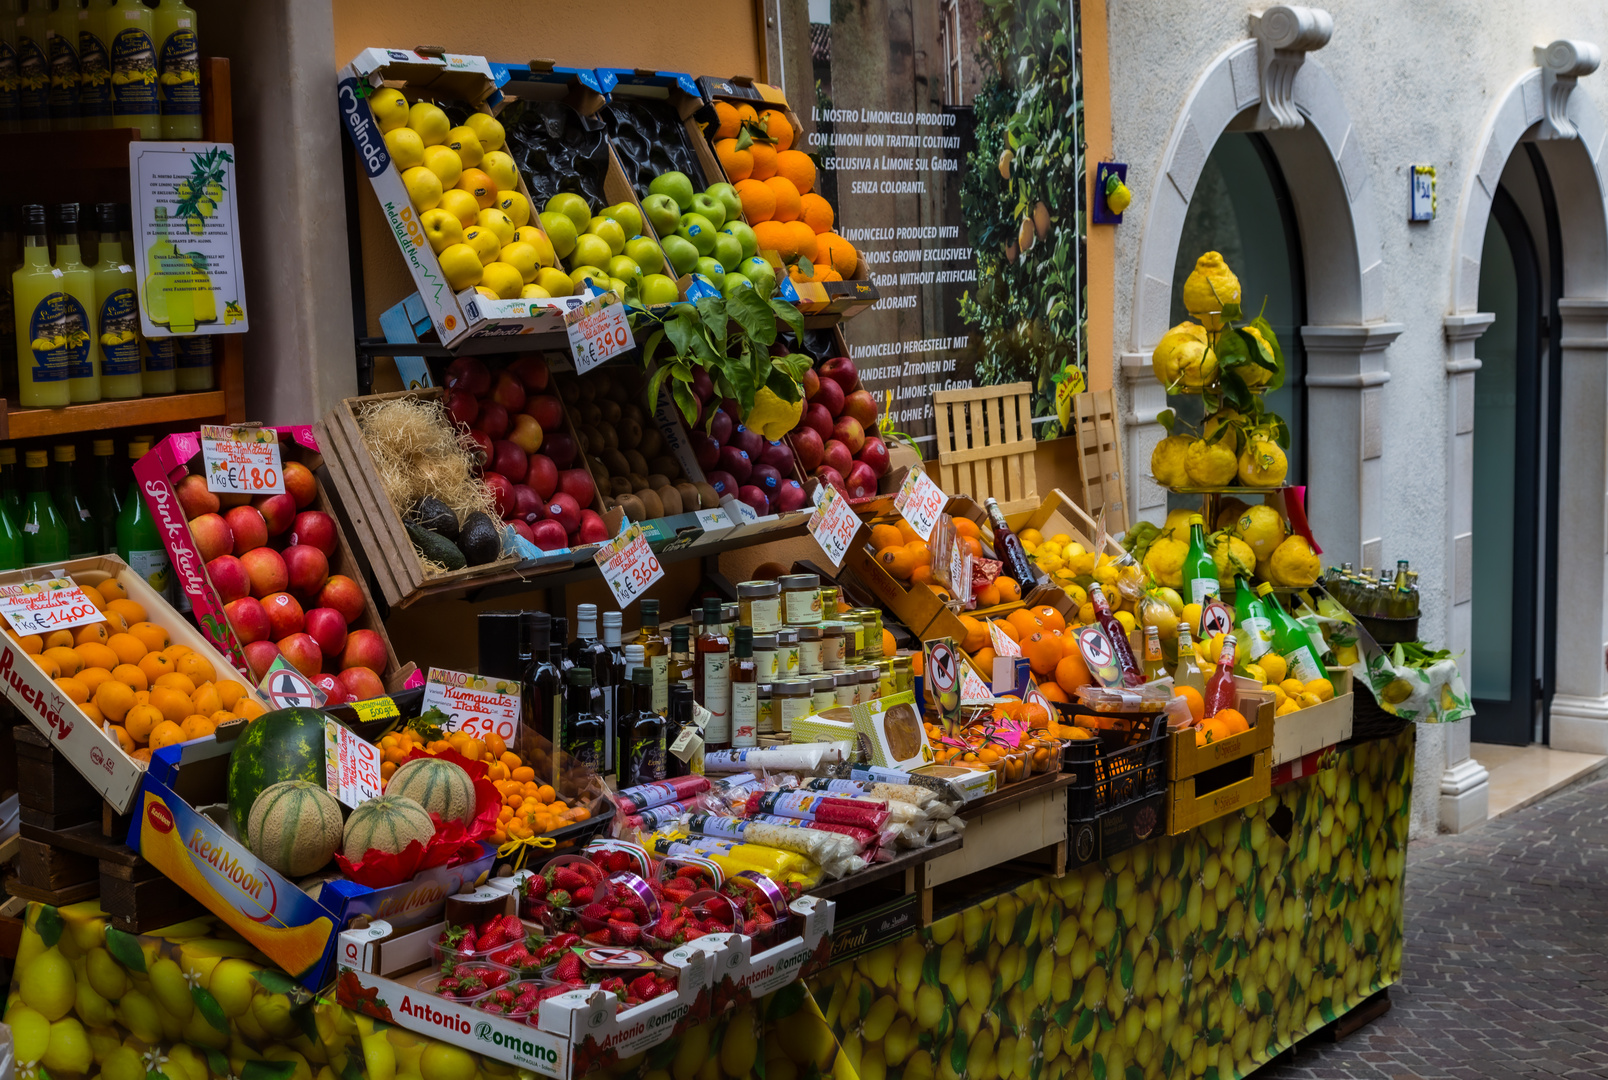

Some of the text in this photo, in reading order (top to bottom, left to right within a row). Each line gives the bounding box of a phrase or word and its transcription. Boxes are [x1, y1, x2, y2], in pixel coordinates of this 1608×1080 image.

[811, 105, 957, 126] IL NOSTRO LIMONCELLO PRODOTTO
[338, 86, 382, 174] Melinda
[808, 133, 961, 149] CON LIMONI NON TRATTATI COLTIVATI
[825, 155, 958, 172] ESCLUSIVA A LIMONE SUL GARDA
[851, 181, 927, 194] SENZA COLORANTI.
[841, 226, 959, 241] LIMONCELLO PRODUCED WITH
[892, 250, 922, 263] GROWN
[923, 247, 973, 262] EXCLUSIVELY
[869, 269, 977, 287] GARDA WITHOUT ARTIFICIAL
[596, 326, 627, 356] 3,90
[849, 336, 969, 359] LIMONCELLO HERGESTELLT MIT
[903, 360, 941, 377] ZITRONEN
[943, 359, 957, 372] DIE
[896, 385, 927, 400] LIMONE
[1058, 371, 1080, 400] MIMO
[901, 408, 923, 423] OHNE
[204, 426, 233, 439] MIMO
[210, 465, 277, 490] 1 Kg € 4,80
[923, 490, 942, 520] 4,80
[145, 480, 203, 595] Pink Lady
[620, 588, 630, 599] Kg
[625, 576, 637, 595] €
[632, 556, 659, 587] 3,50
[15, 604, 96, 631] 1 Kg € 14,00
[431, 669, 468, 685] MIMO
[0, 645, 73, 741] Ruchey
[444, 685, 517, 708] Kumquats:
[370, 708, 384, 718] 500
[452, 701, 492, 715] Italia
[446, 713, 514, 741] € 6,90
[358, 742, 379, 791] 5,90
[327, 763, 337, 796] MIMO
[345, 943, 358, 960] Q
[737, 964, 775, 990] Antonio
[776, 949, 814, 973] Romano
[399, 995, 558, 1065] Antonio Romano
[602, 1021, 645, 1051] Antonio
[646, 1004, 689, 1031] Romano
